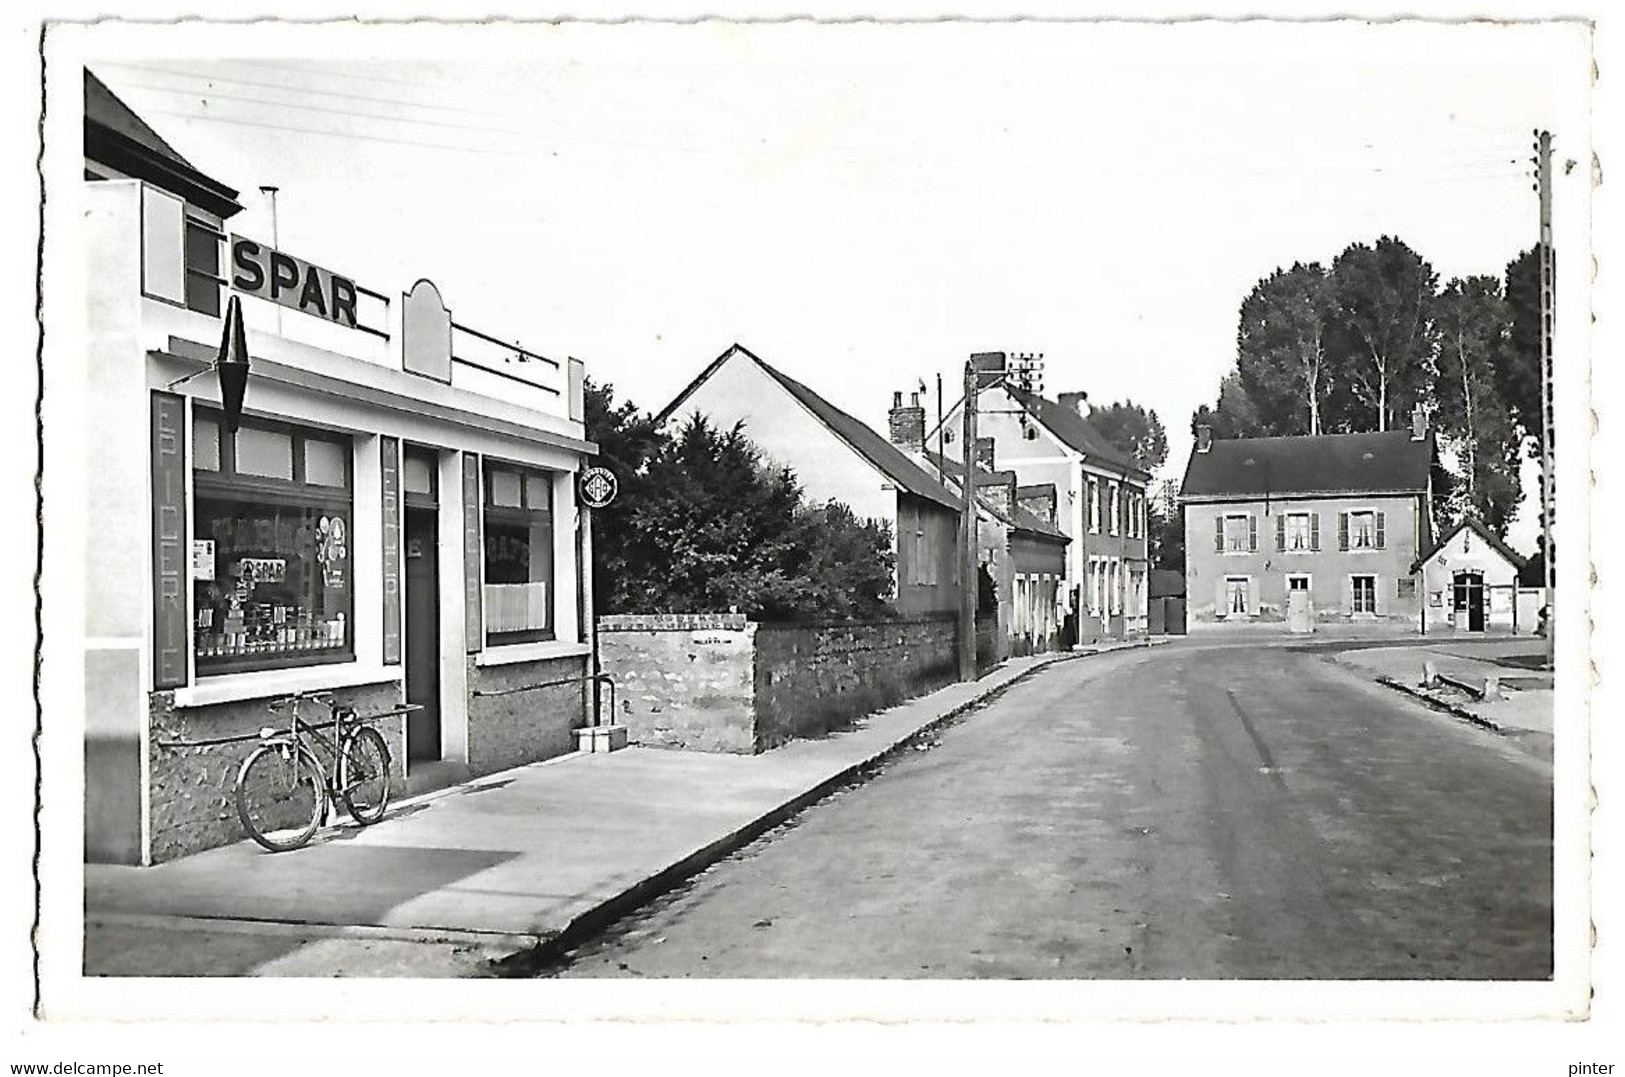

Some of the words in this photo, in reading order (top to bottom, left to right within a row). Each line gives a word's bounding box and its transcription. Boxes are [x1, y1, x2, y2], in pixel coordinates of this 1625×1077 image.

[233, 240, 357, 325] SPAR
[158, 397, 181, 684] EPICERIE
[254, 561, 284, 580] SPAR
[383, 439, 399, 661] MERCERIE
